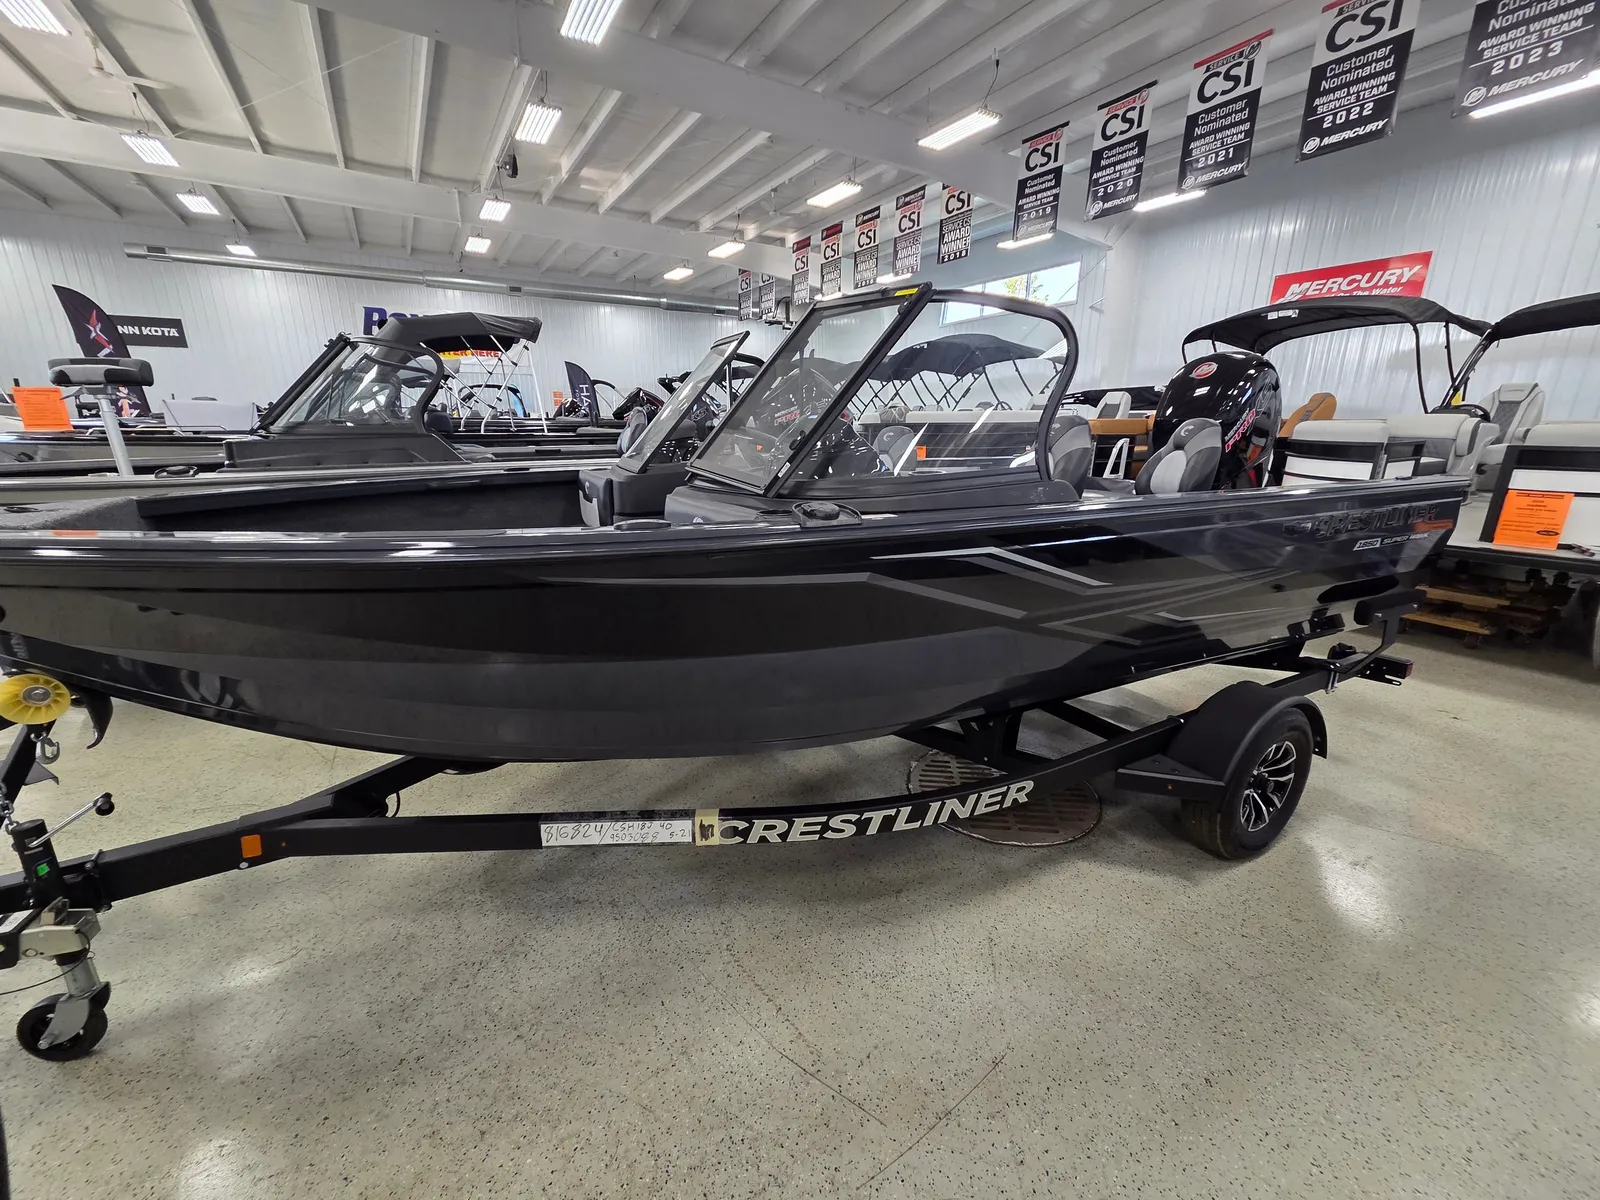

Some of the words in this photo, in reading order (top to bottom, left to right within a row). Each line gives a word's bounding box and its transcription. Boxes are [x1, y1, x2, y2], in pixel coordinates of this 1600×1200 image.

[1325, 0, 1404, 53] CSI
[1478, 25, 1527, 51] AWARD
[1529, 2, 1595, 33] WINNING
[1483, 32, 1540, 60] SERVICE
[1543, 17, 1583, 39] TEAM
[1209, 52, 1240, 71] SERVICE
[1327, 45, 1394, 77] Customer
[1490, 40, 1563, 76] 2023
[1197, 59, 1255, 104] CSI
[1320, 55, 1394, 91] Nominated
[1487, 58, 1585, 97] MERCURY
[1313, 88, 1347, 107] AWARD
[1350, 72, 1396, 94] WINNING
[1317, 94, 1357, 114] SERVICE
[1359, 84, 1388, 102] TEAM
[1101, 105, 1145, 141] CSI
[1194, 108, 1249, 137] Nominated
[1198, 99, 1248, 125] Customer
[1322, 102, 1374, 129] 2022
[1189, 134, 1215, 149] AWARD
[1216, 122, 1251, 140] WINNING
[1320, 118, 1389, 147] MERCURY
[1103, 141, 1137, 157] Customer
[1192, 139, 1221, 156] SERVICE
[1223, 132, 1245, 146] TEAM
[1025, 141, 1060, 172] CSI
[1092, 166, 1114, 179] AWARD
[1115, 156, 1144, 171] WINNING
[1100, 147, 1138, 166] Nominated
[1198, 147, 1234, 168] 2021
[1027, 173, 1055, 187] Customer
[1099, 172, 1120, 183] SERVICE
[1121, 167, 1136, 176] TEAM
[1196, 161, 1247, 184] MERCURY
[1018, 195, 1036, 206] AWARD
[1037, 187, 1060, 200] WINNING
[1025, 179, 1056, 195] Nominated
[1097, 179, 1133, 196] 2020
[945, 190, 971, 215] CSI
[1024, 200, 1040, 209] SERVICE
[1041, 196, 1054, 204] TEAM
[1103, 193, 1138, 209] MERCURY
[898, 211, 920, 233] CSI
[1023, 206, 1051, 221] 2019
[942, 220, 963, 234] SERVICE
[963, 217, 971, 228] CS
[943, 226, 971, 244] AWARD
[857, 229, 876, 248] CSI
[823, 243, 839, 260] CSI
[897, 244, 920, 260] AWARD
[795, 256, 808, 271] CSI
[857, 259, 877, 272] AWARD
[741, 277, 751, 291] CSI
[1281, 264, 1424, 300] MERCURY
[1371, 286, 1404, 296] Water
[141, 326, 179, 337] KOTA
[1381, 535, 1409, 545] SUPER
[718, 780, 1036, 846] CRESTLINER
